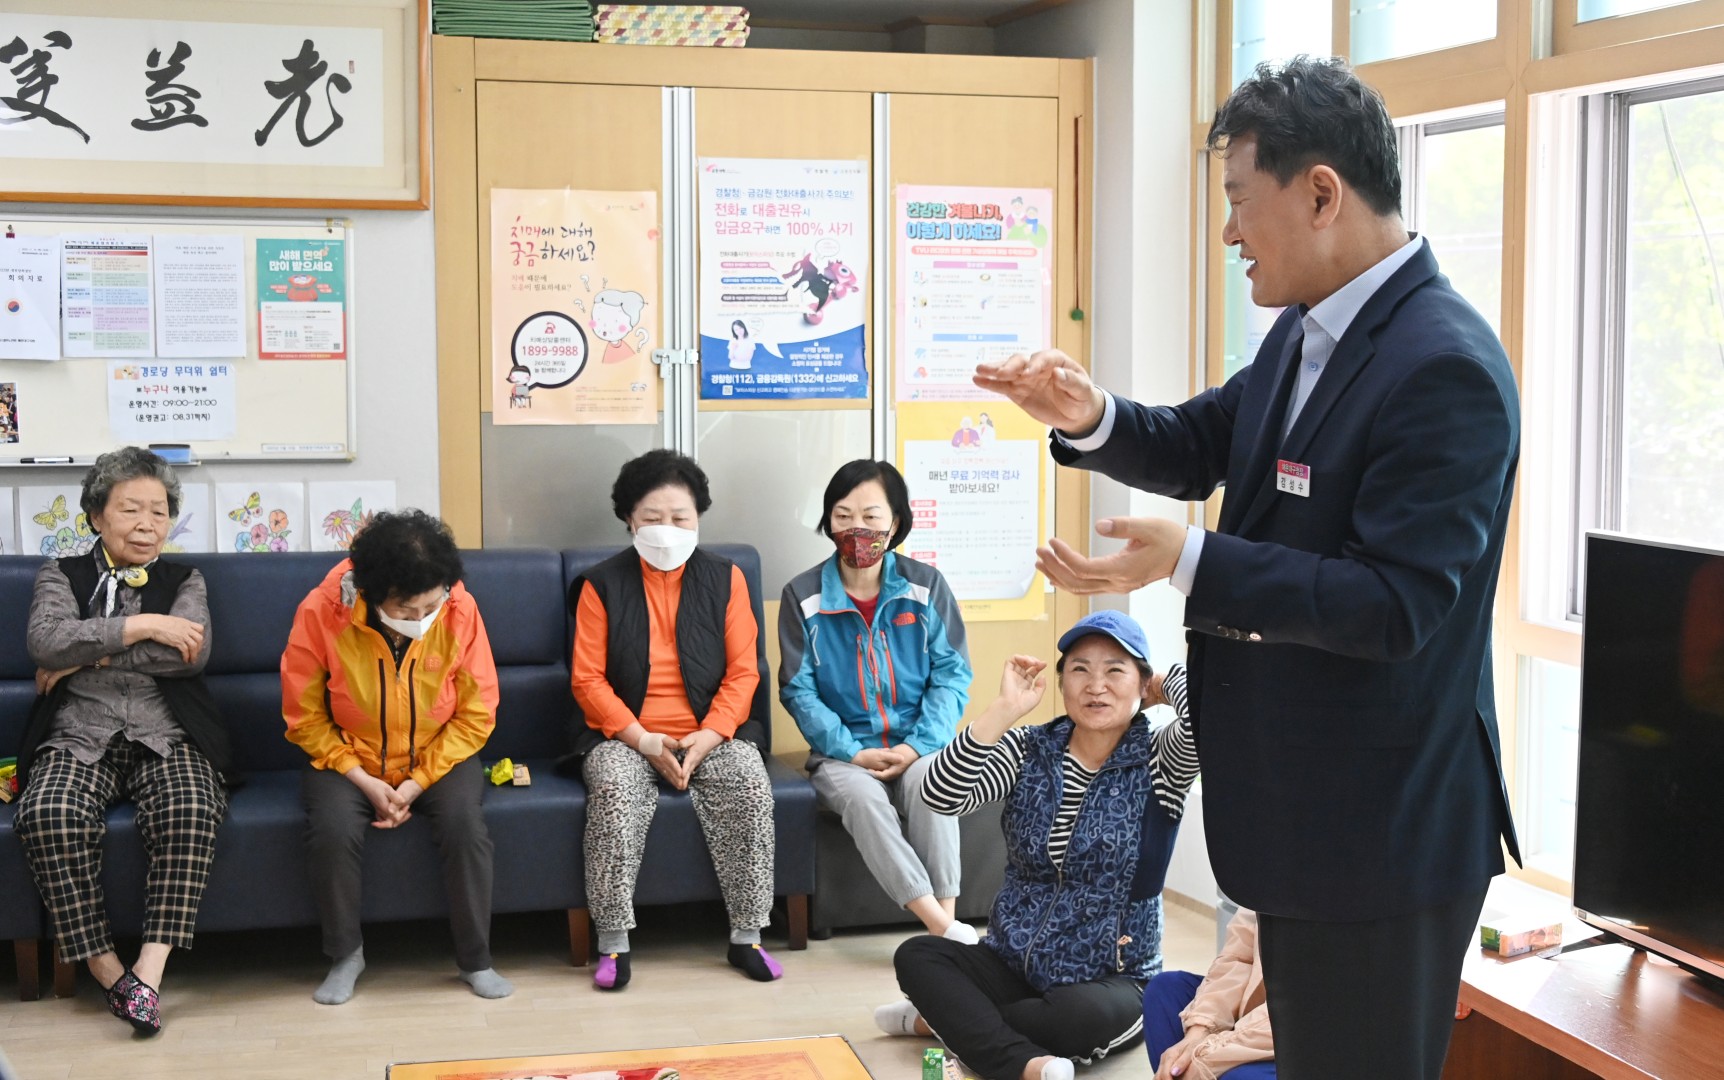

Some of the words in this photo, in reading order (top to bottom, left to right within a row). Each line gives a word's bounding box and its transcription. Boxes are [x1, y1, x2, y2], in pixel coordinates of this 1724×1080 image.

[715, 203, 748, 217] 전화로
[752, 203, 811, 217] 대출권유시
[907, 202, 947, 218] 건강한
[948, 203, 1003, 221] 겨울나기,
[511, 215, 554, 238] 치매에
[560, 222, 593, 238] 대해
[714, 221, 781, 235] 입금요구하면
[786, 222, 824, 236] 100%
[828, 222, 853, 236] 사기
[907, 222, 951, 240] 이렇게
[953, 222, 1001, 240] 하세요!
[280, 250, 300, 260] 새해
[304, 250, 323, 260] 면역
[510, 240, 595, 267] 궁금하세요?
[269, 261, 290, 271] 많이
[292, 261, 333, 271] 받으세요
[522, 346, 579, 356] 1899-9988
[141, 366, 168, 377] 경로당
[175, 366, 203, 377] 무더위
[210, 366, 227, 377] 쉼터
[929, 470, 948, 480] 매년
[951, 470, 969, 480] 무료
[972, 470, 999, 480] 기억력
[1002, 470, 1020, 480] 검사
[949, 483, 1000, 493] 받아보세요!
